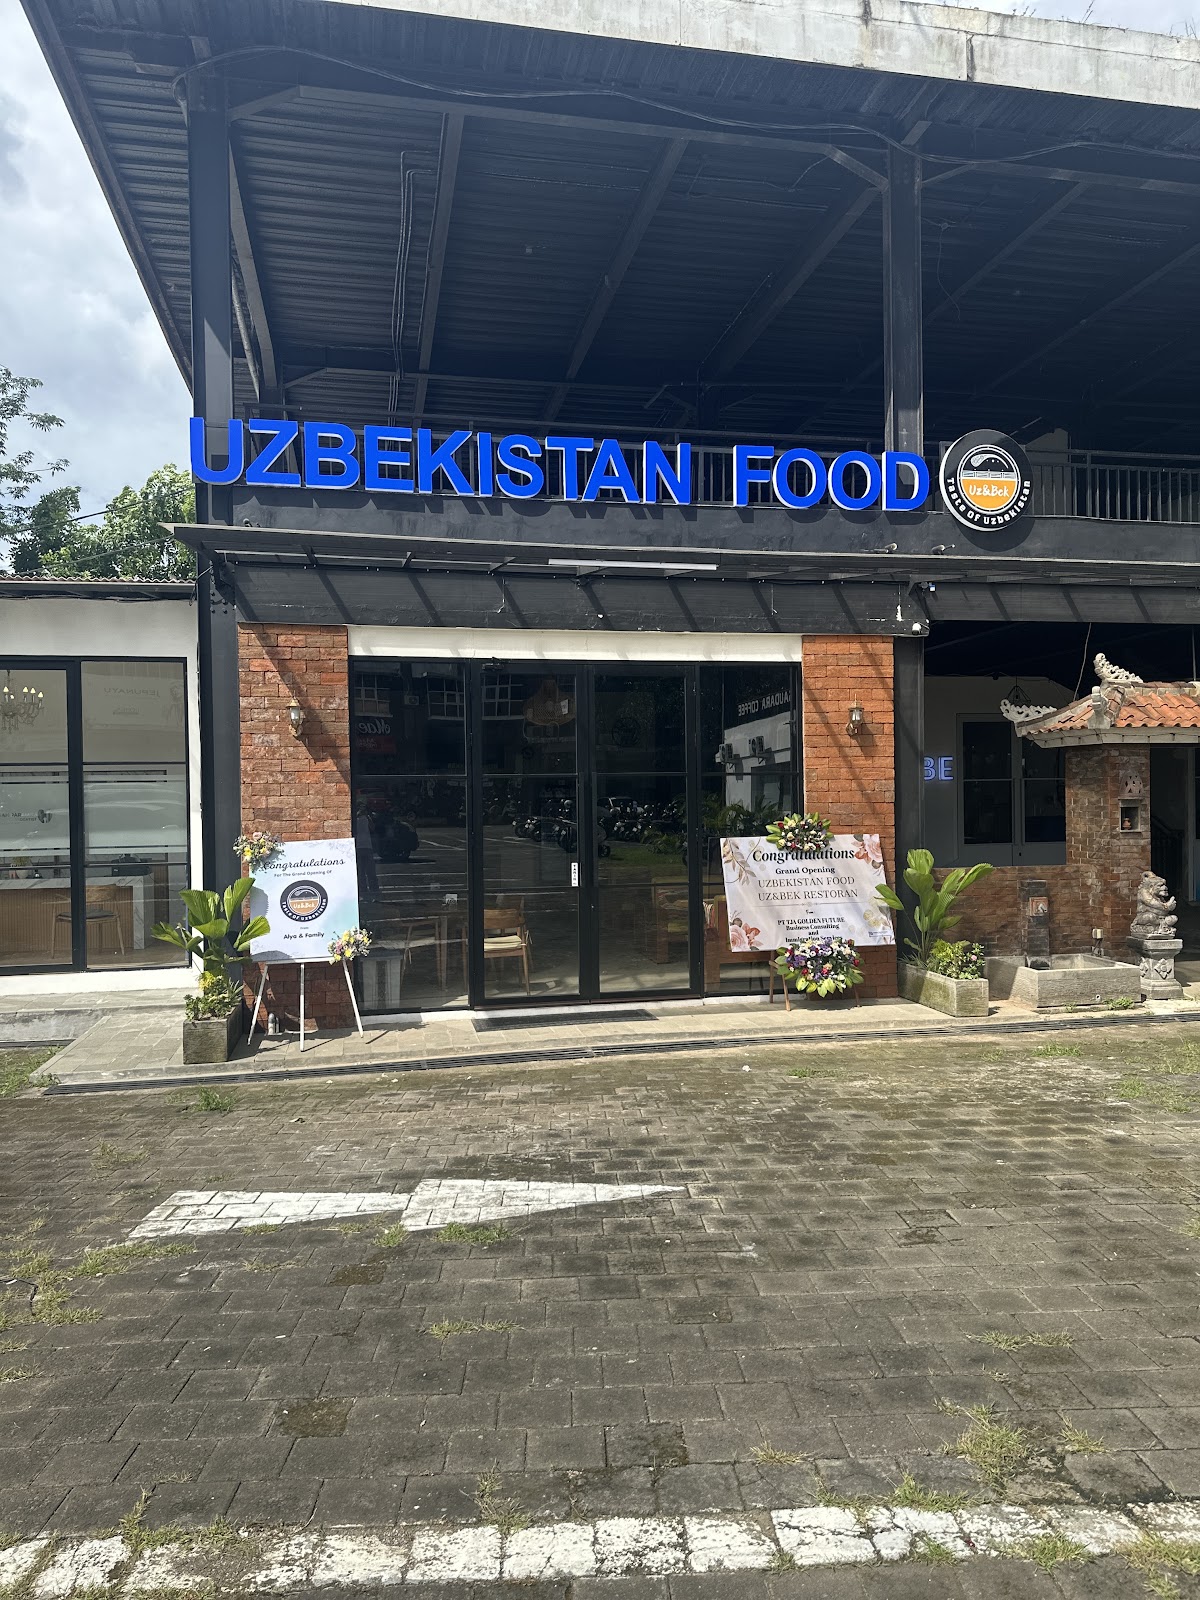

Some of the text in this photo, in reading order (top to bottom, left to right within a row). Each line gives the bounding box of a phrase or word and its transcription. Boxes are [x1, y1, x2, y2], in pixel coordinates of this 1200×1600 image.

[189, 416, 930, 511] UZBEKISTAN FOOD
[968, 484, 1010, 498] Uz&Bek
[263, 857, 345, 872] Congratulations
[775, 866, 836, 875] Grand Opening
[758, 876, 856, 888] UZBEKISTAN FOOD
[758, 888, 859, 901] UZ&BEK RESTORAN
[283, 933, 298, 941] Alya
